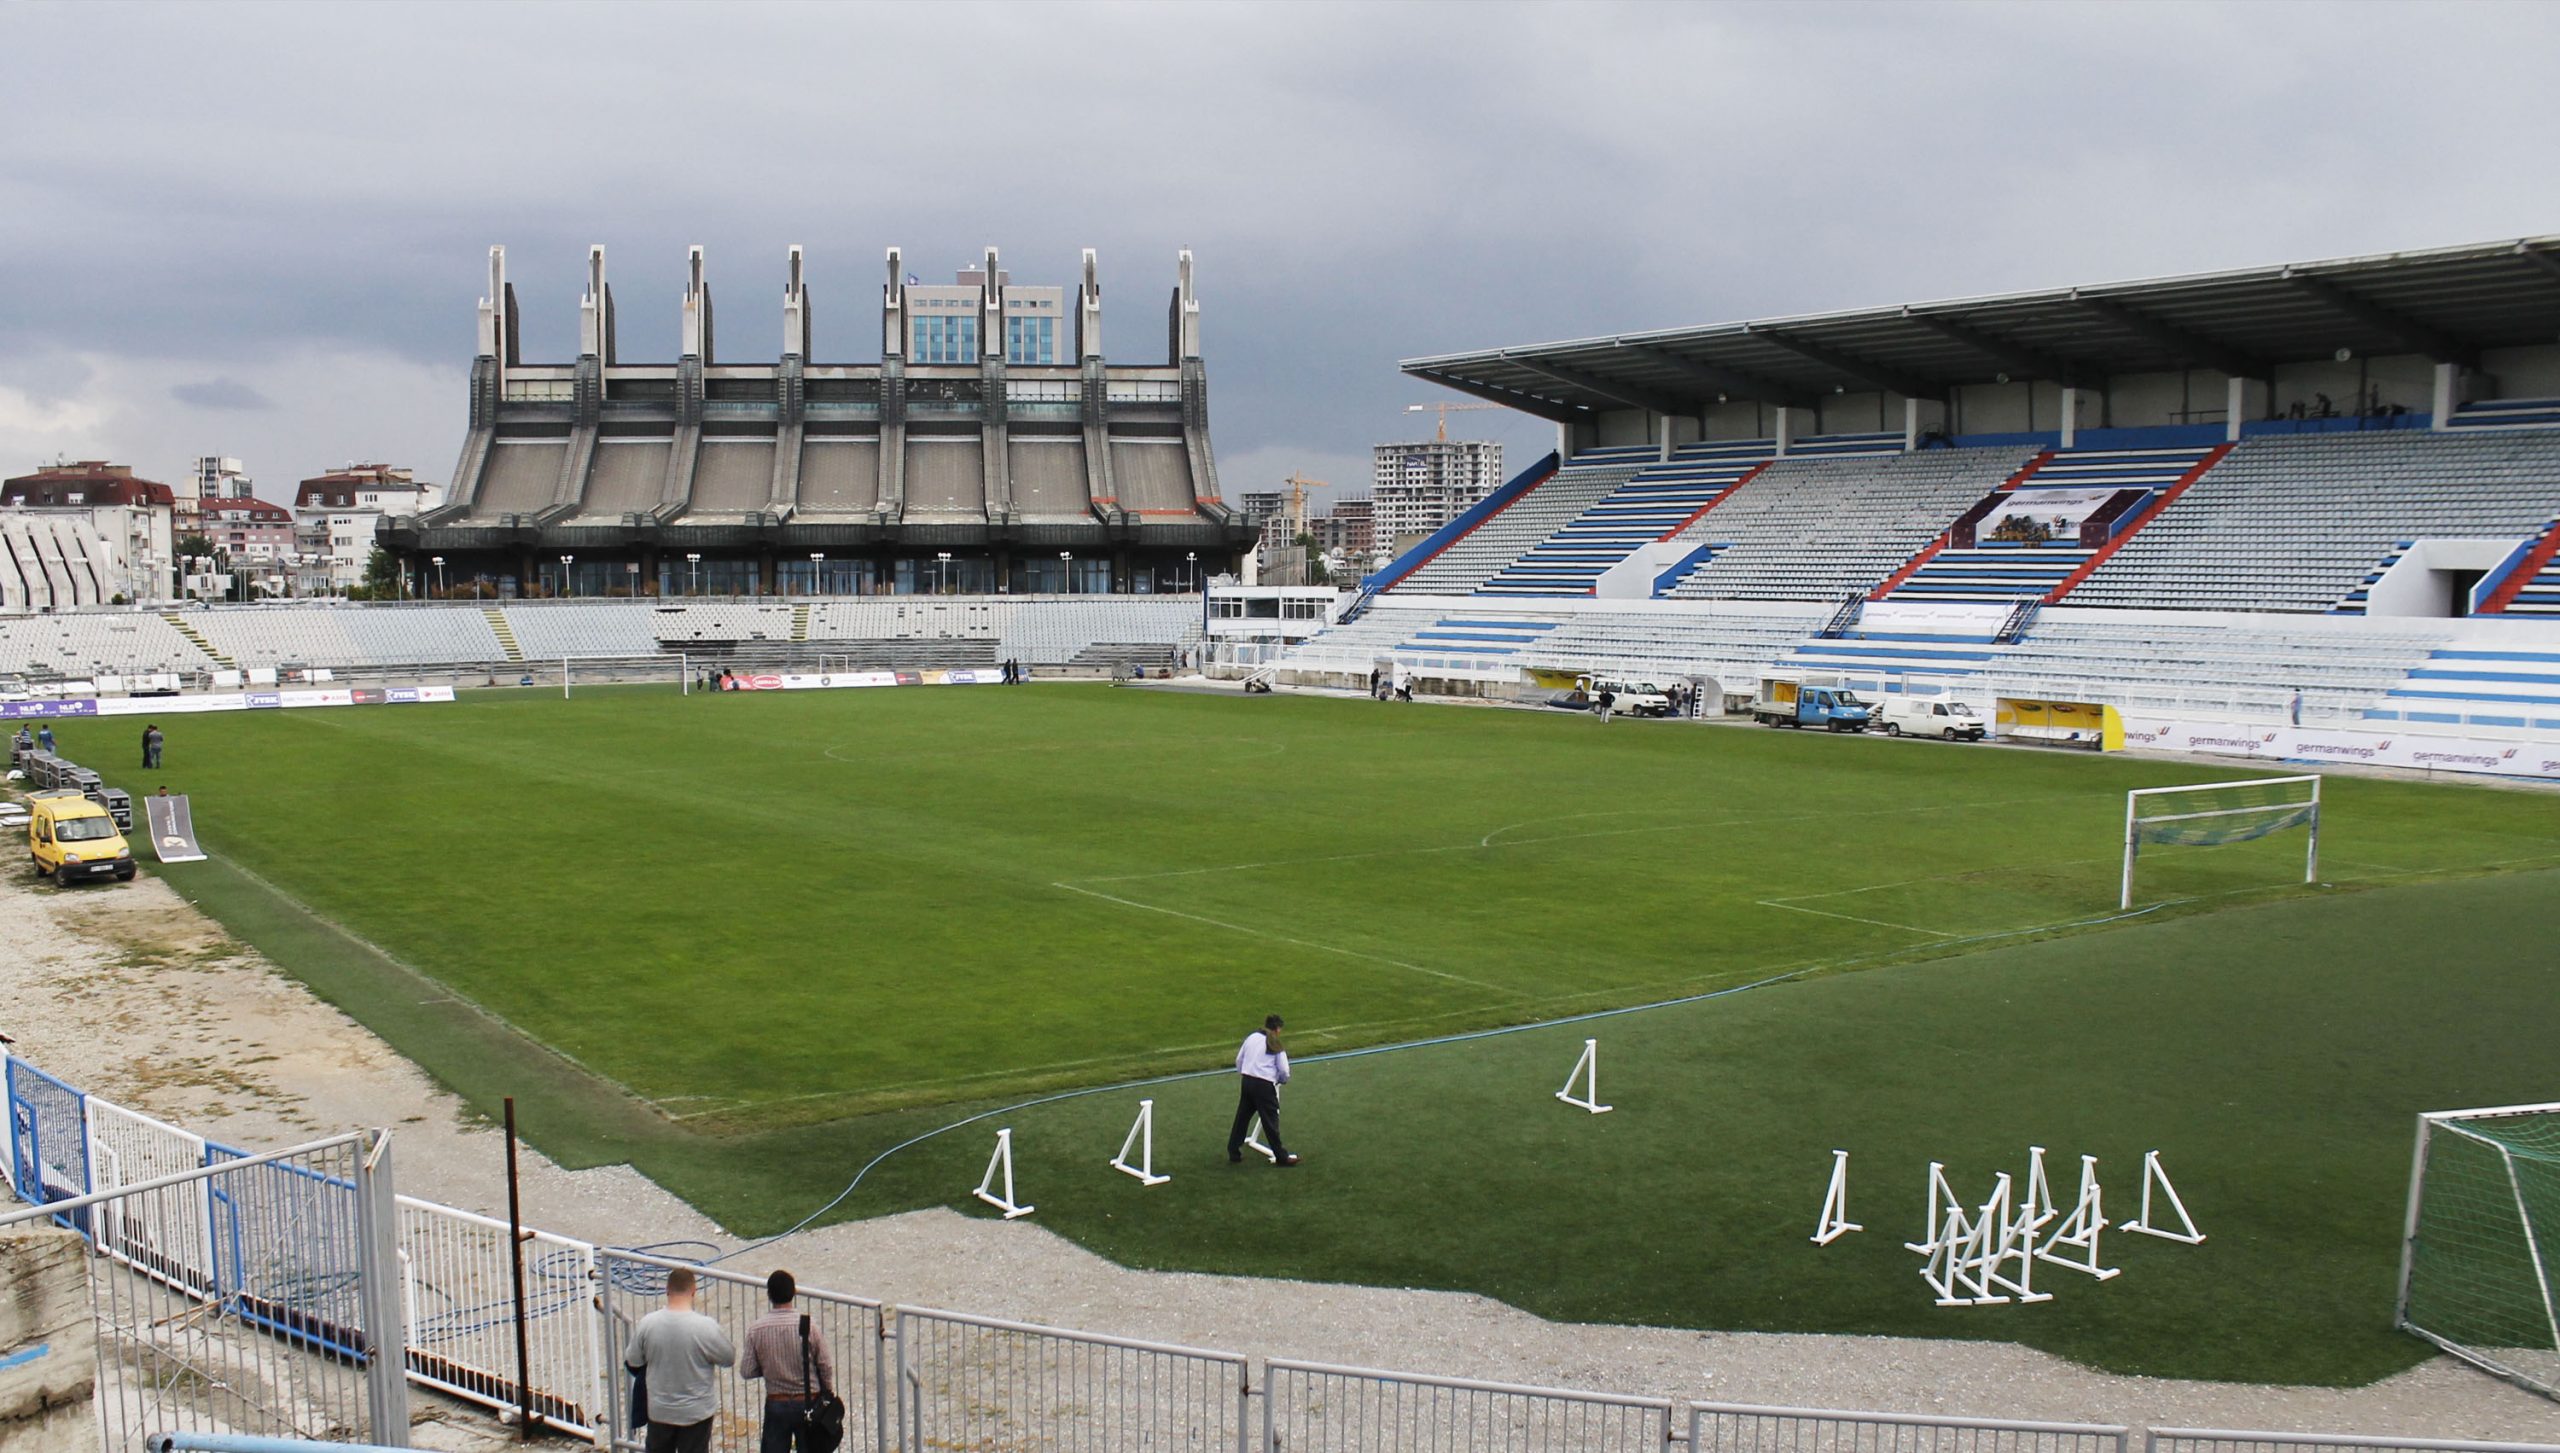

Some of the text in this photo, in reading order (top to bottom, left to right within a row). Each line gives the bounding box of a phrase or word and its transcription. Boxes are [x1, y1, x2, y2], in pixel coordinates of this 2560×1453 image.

[253, 695, 280, 706] JYSK
[393, 690, 417, 700] JYSK
[2189, 735, 2260, 750] germanwings
[2296, 743, 2375, 758] germanwings
[2413, 752, 2499, 767] germanwings
